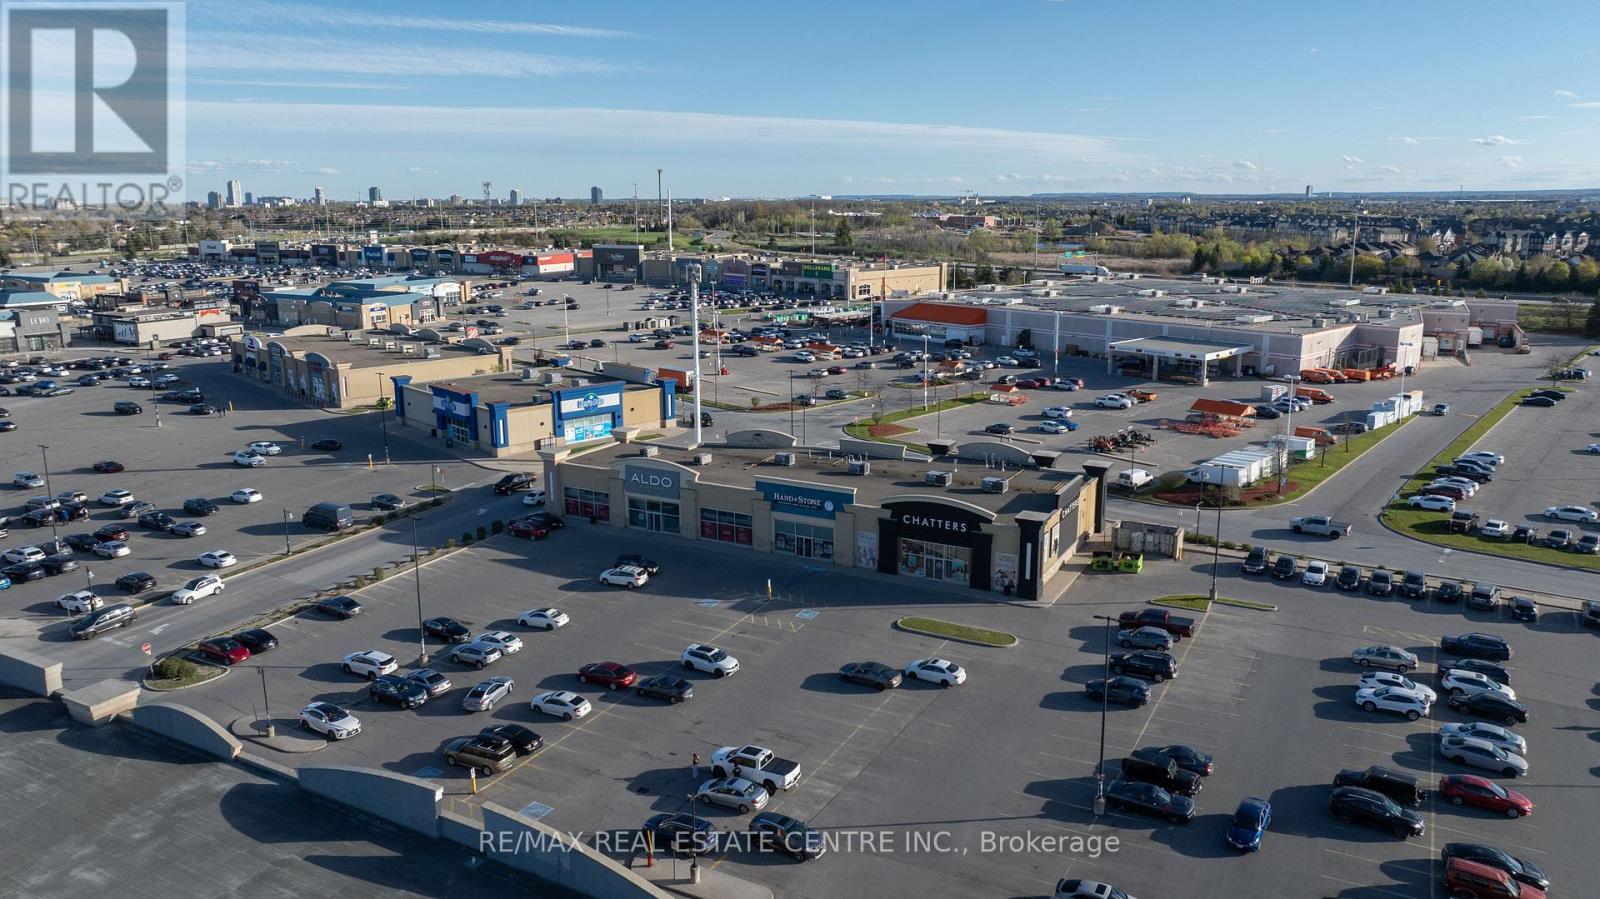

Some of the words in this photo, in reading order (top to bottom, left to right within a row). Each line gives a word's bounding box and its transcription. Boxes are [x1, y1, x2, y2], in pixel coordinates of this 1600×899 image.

[631, 472, 673, 488] ALDO
[773, 492, 794, 502] HAND
[798, 496, 822, 506] STONE
[902, 514, 968, 533] CHATTERS
